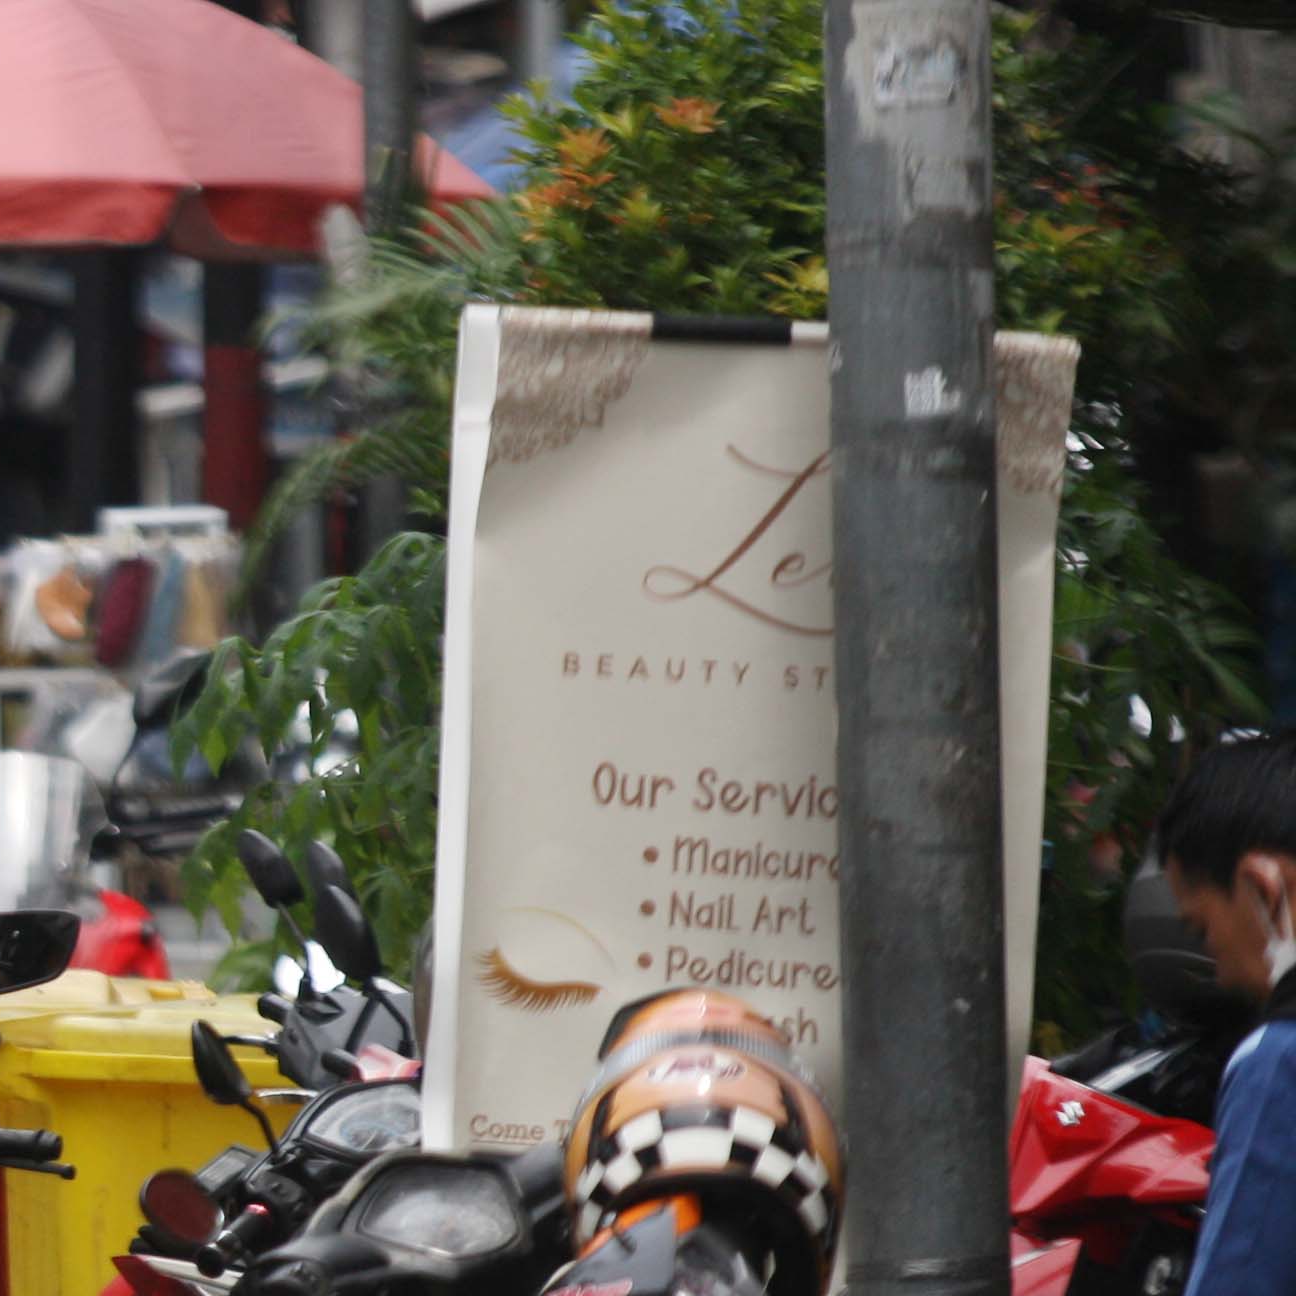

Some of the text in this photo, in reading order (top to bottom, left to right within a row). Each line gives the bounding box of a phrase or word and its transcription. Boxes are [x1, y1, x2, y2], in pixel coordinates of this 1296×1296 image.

[563, 653, 749, 687] BEAUTY
[592, 762, 675, 808] Our
[669, 891, 815, 934] Nail Art
[665, 946, 839, 990] Pedicure
[469, 1114, 545, 1142] Come
